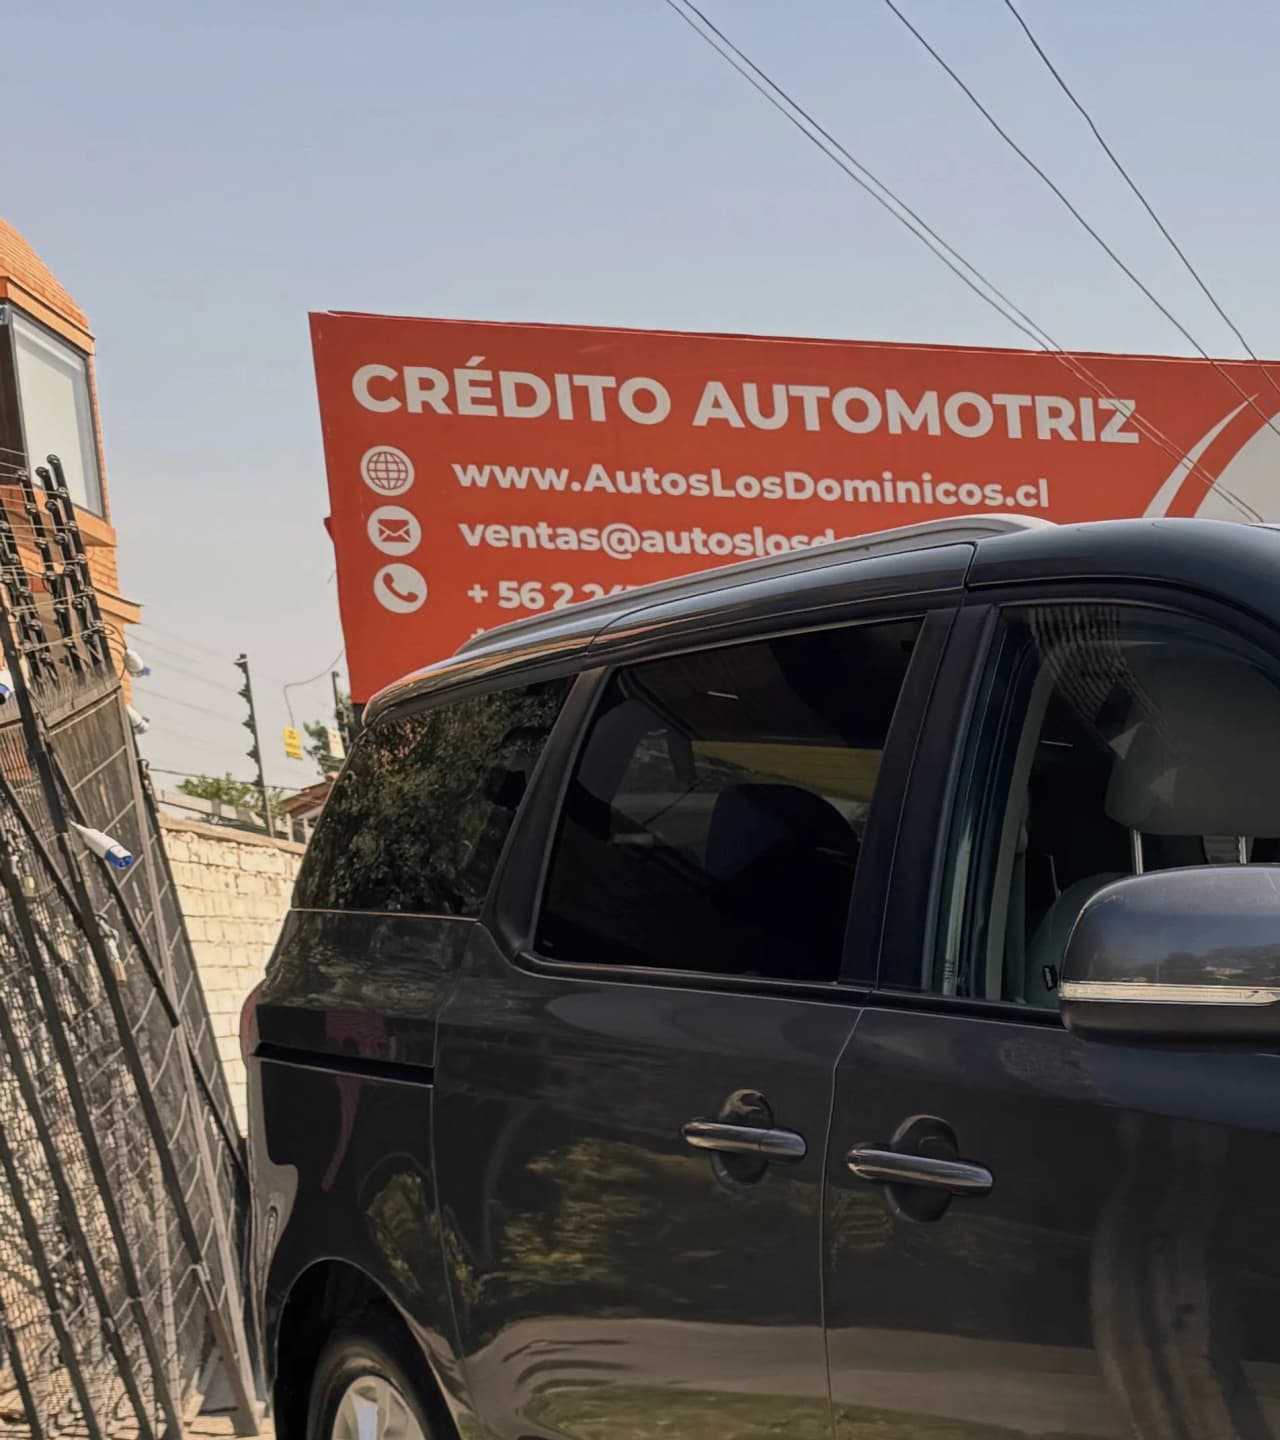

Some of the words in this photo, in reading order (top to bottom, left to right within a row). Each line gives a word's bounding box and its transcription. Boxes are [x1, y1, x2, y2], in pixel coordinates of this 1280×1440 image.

[352, 356, 671, 425] CRÉDITO
[692, 380, 1139, 443] AUTOMOTRIZ
[452, 463, 1049, 508] www.AutosLosDominicos.cl
[498, 580, 545, 610] 56
